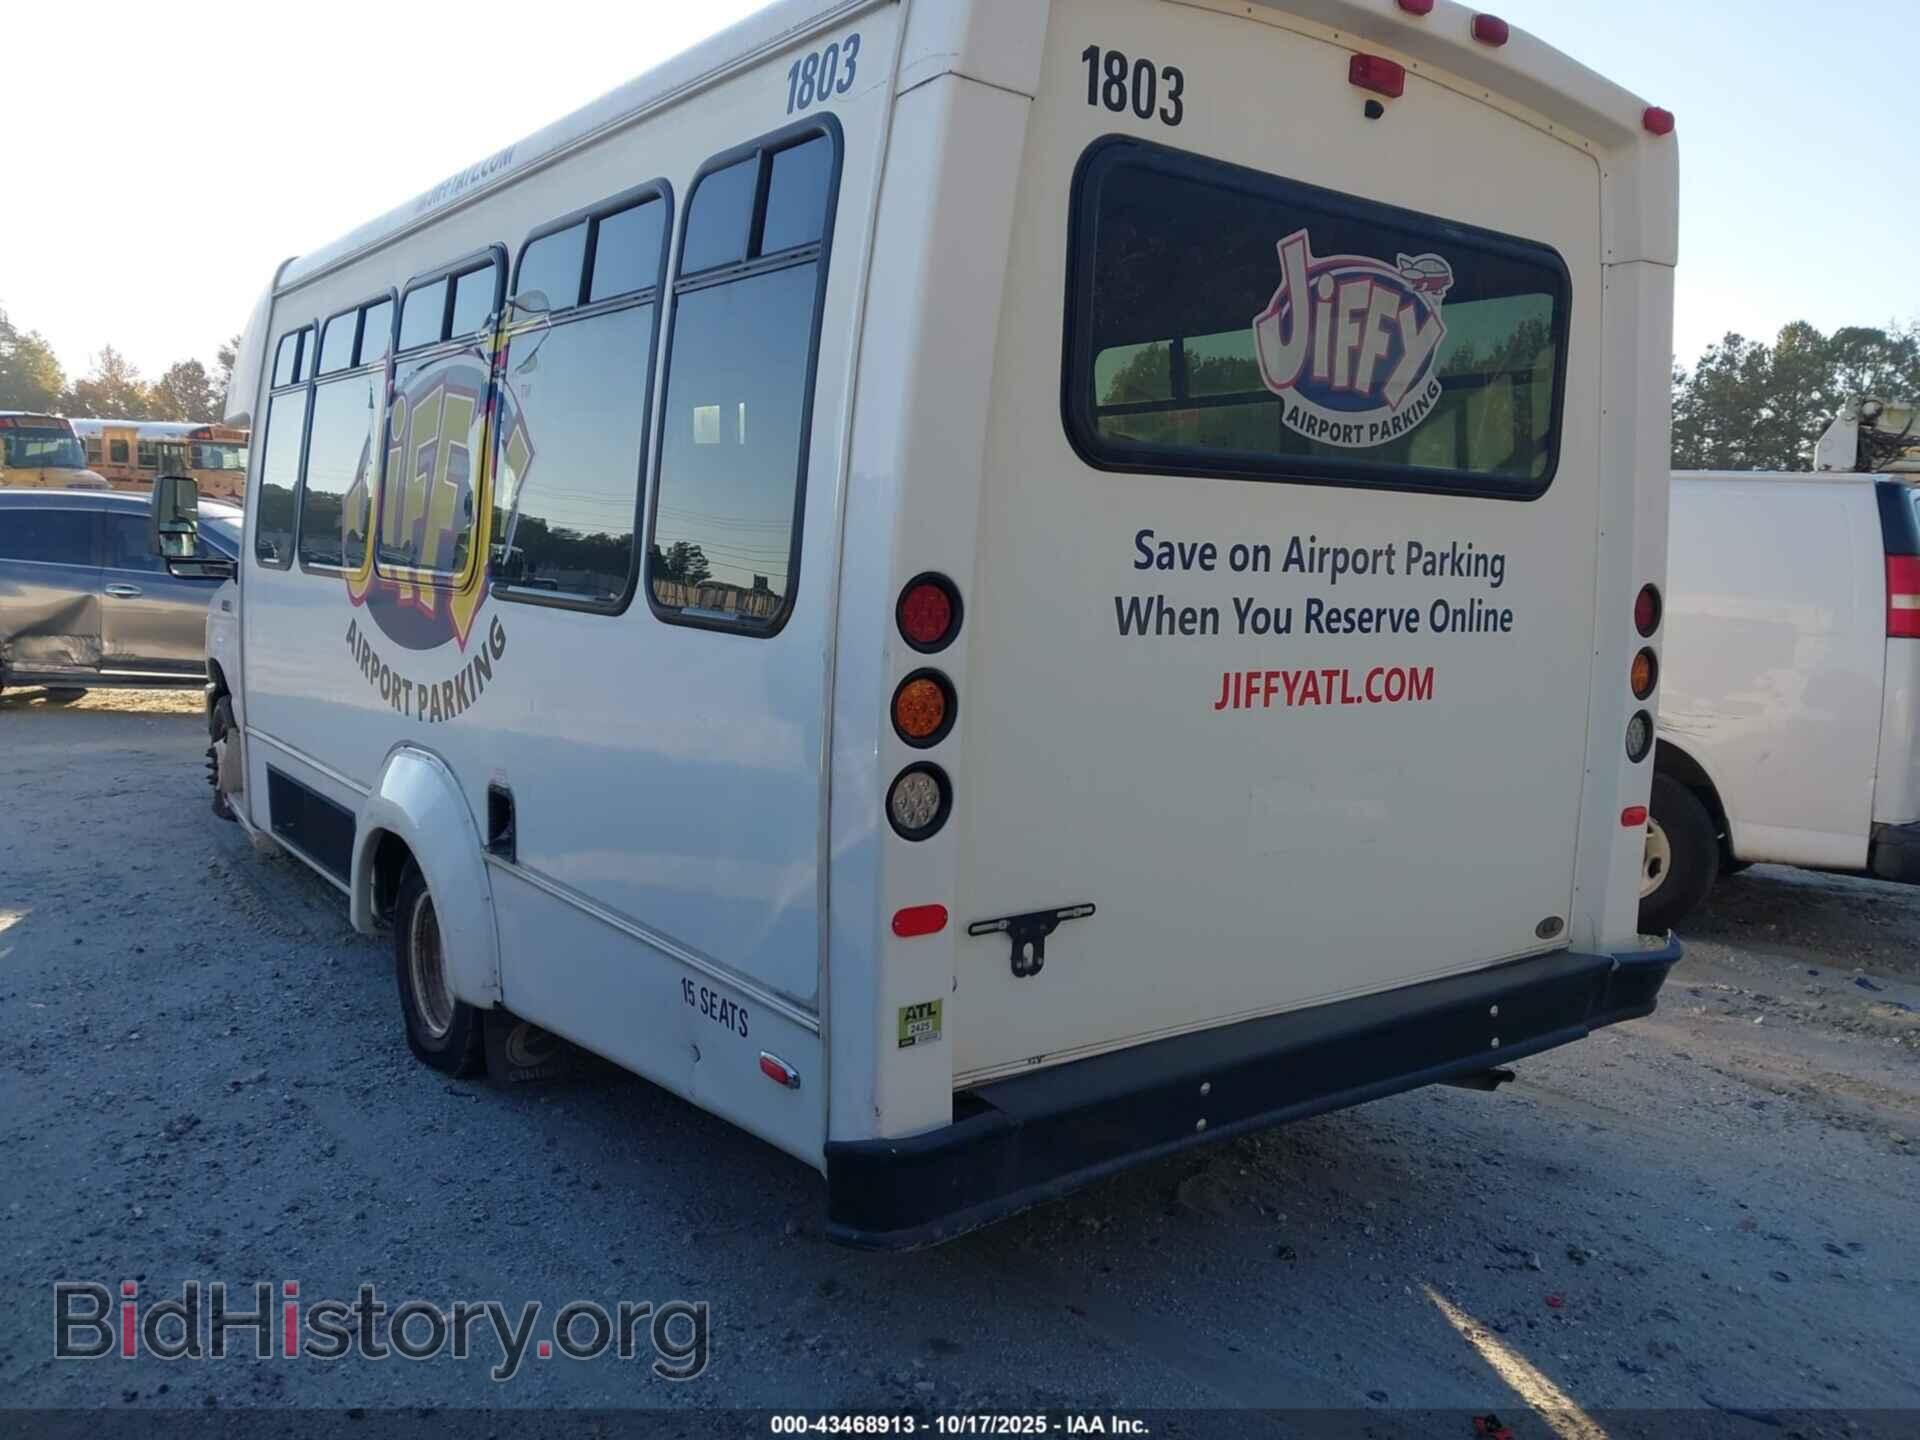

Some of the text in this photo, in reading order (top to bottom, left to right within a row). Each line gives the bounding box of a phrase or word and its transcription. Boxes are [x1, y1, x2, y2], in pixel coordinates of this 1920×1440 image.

[787, 33, 860, 115] 1803
[1082, 45, 1184, 126] 1803
[1286, 382, 1440, 443] AIRPORT PARKING
[1134, 529, 1506, 588] Save on Airport Parking
[1115, 595, 1513, 636] When You Reserve Online
[345, 614, 507, 723] AIRPORT PARKING
[1214, 666, 1434, 710] JIFFYATL.COM
[681, 977, 748, 1038] 15 SEATS
[904, 1002, 936, 1021] ATL
